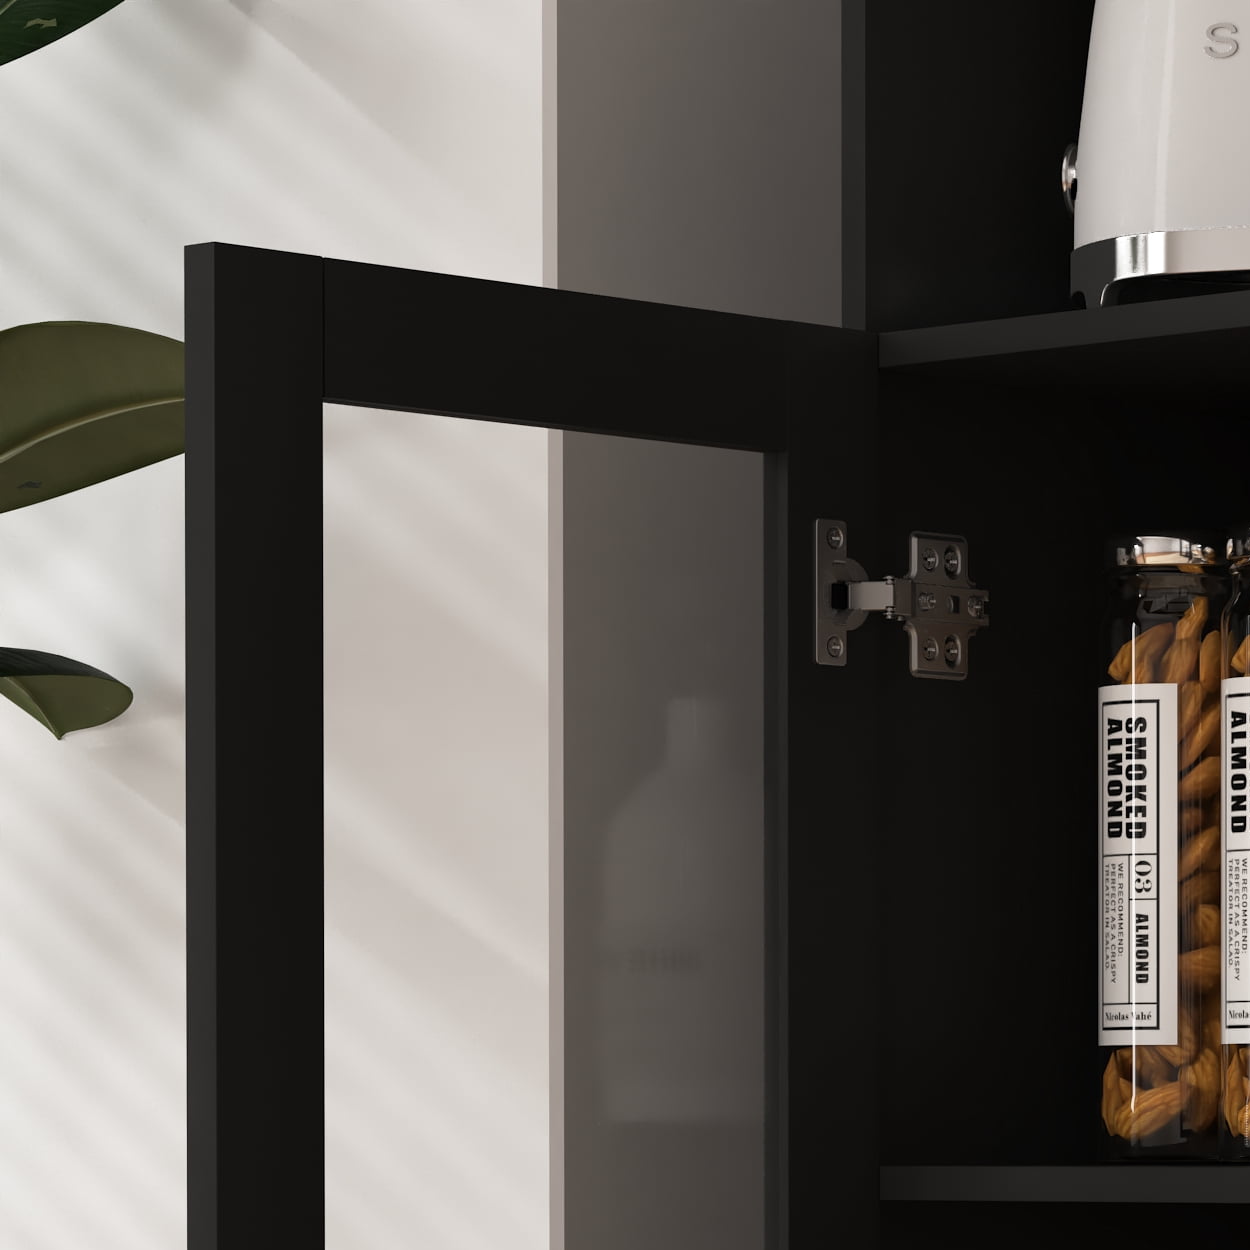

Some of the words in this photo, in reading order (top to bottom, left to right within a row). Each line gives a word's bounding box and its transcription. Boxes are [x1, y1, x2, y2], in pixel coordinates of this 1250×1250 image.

[1108, 718, 1122, 839] ALMOND
[1126, 717, 1146, 839] SMOKED
[1231, 711, 1246, 834] ALMOND
[1118, 862, 1124, 878] WE
[1242, 858, 1248, 874] WE
[1135, 860, 1152, 893] 03
[1111, 916, 1116, 930] AS
[1228, 914, 1233, 924] IN
[1234, 912, 1240, 926] AS
[1111, 933, 1116, 941] A
[1136, 913, 1149, 984] ALMOND
[1105, 1012, 1128, 1021] Nicolas
